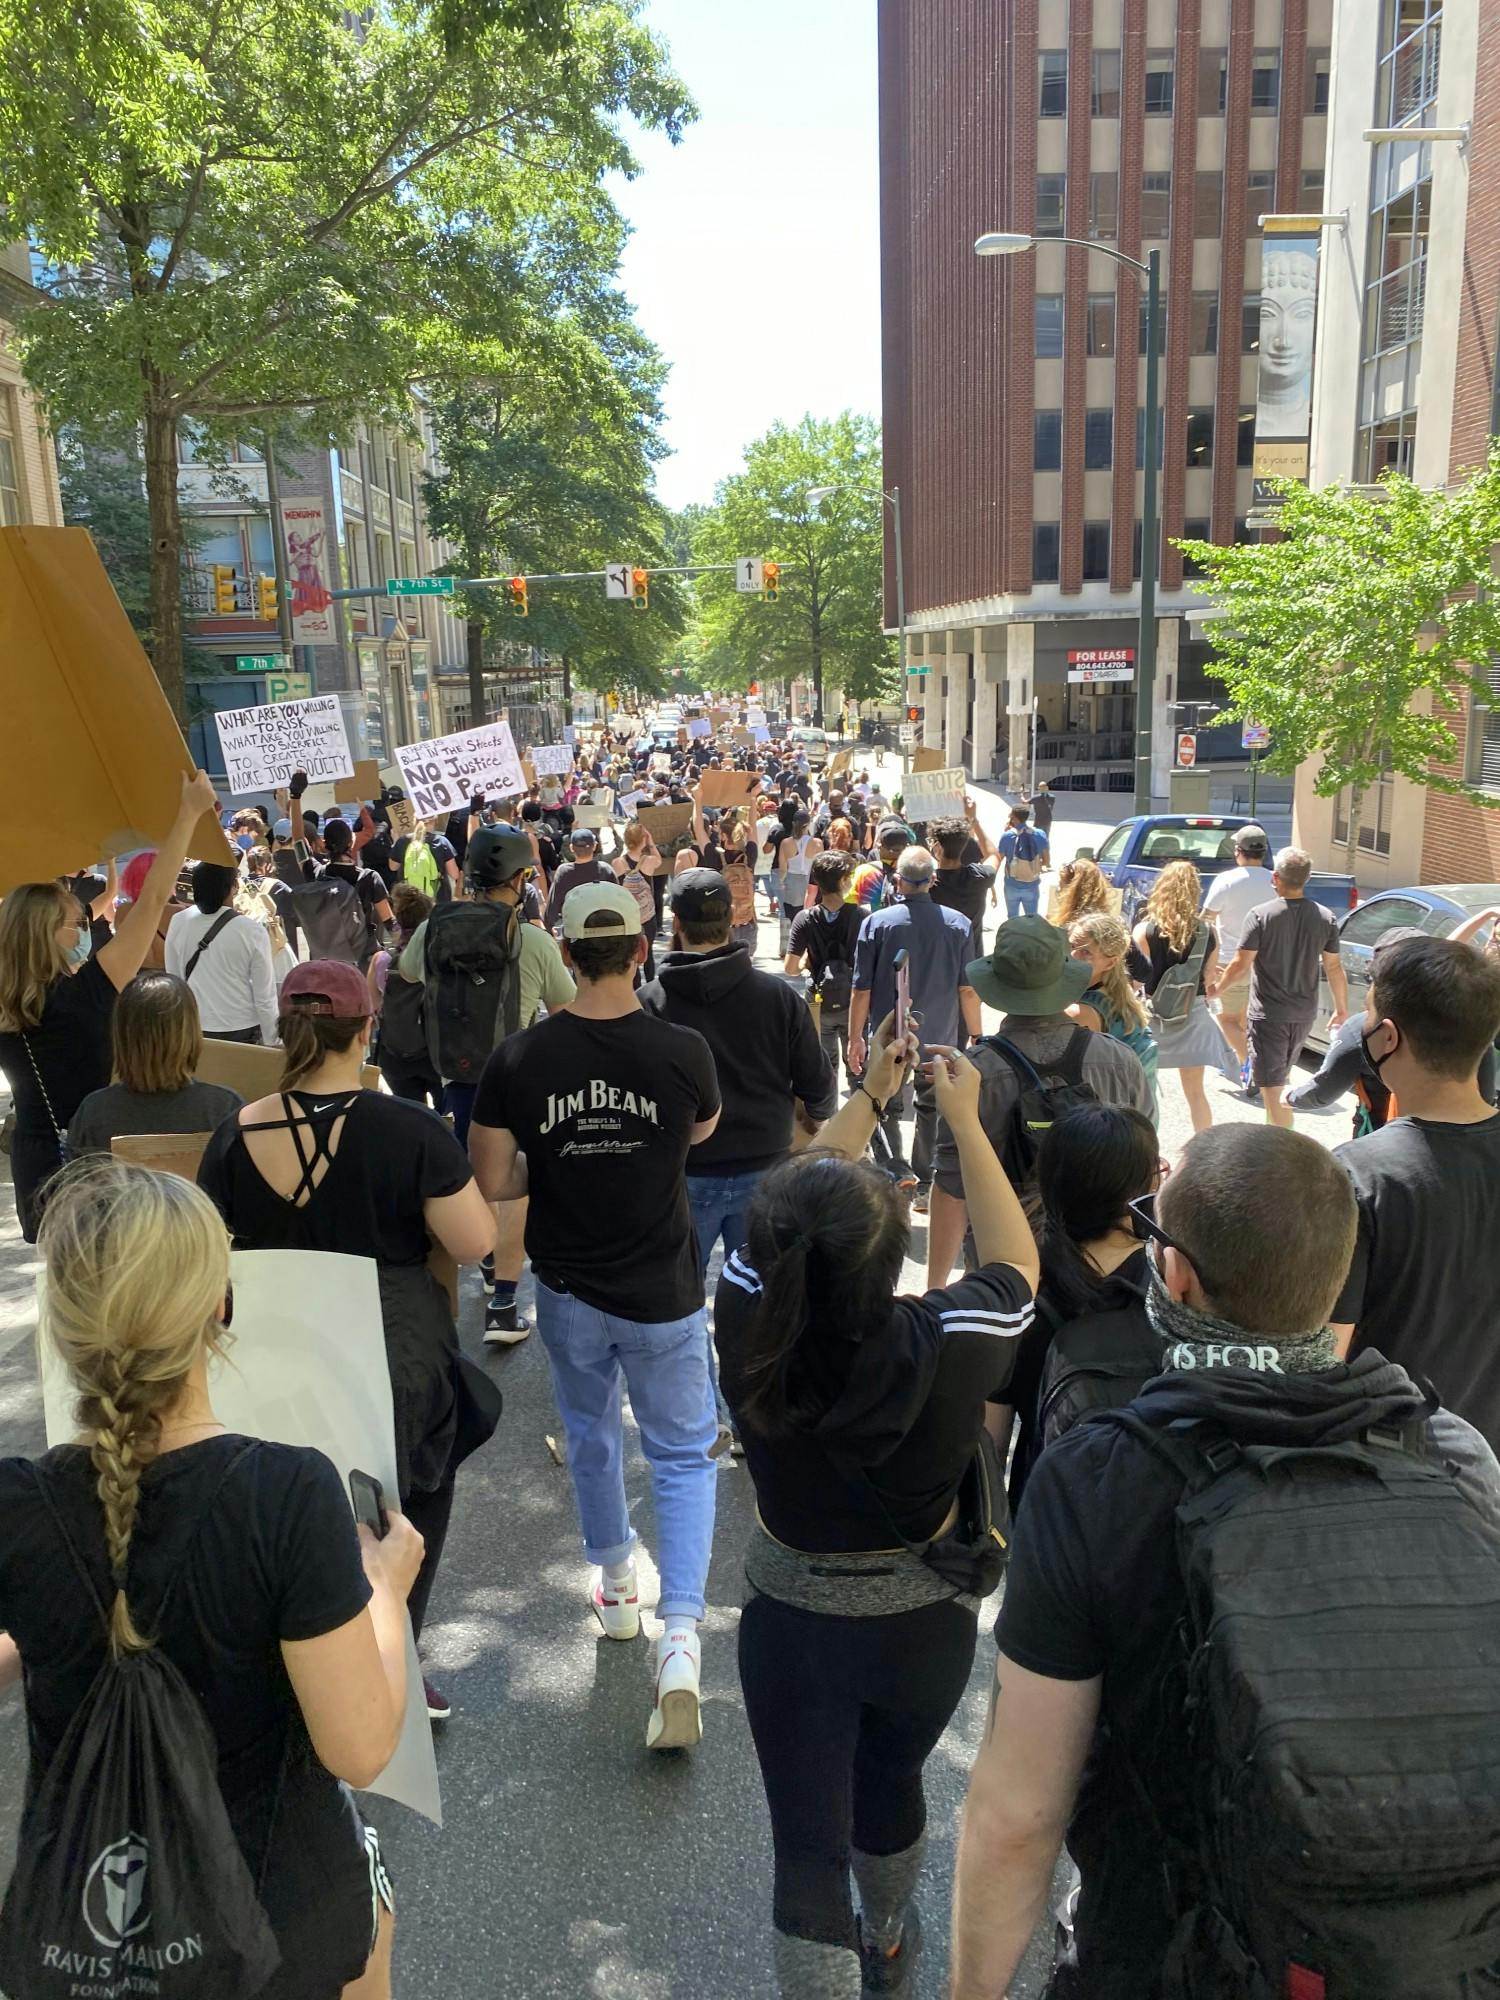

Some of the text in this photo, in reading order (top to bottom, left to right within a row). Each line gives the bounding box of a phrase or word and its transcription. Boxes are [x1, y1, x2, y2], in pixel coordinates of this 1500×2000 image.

[1270, 457, 1288, 467] your
[409, 580, 428, 588] 7th
[251, 658, 268, 669] 7th
[1075, 661, 1127, 670] 804.643.4700
[1076, 650, 1127, 662] FOR LEASE
[270, 679, 289, 702] P
[218, 700, 335, 730] WHAT ARE YOU WILLING
[255, 716, 309, 734] TO RISK
[223, 723, 340, 752] WHAT ARE YOU WILLING
[230, 757, 252, 771] TO
[262, 749, 306, 765] CREATE
[256, 744, 276, 754] TO
[427, 747, 439, 758] IN
[441, 745, 464, 756] THE
[232, 770, 264, 791] MORE
[264, 763, 294, 784] JUST
[403, 762, 442, 788] NO
[444, 756, 502, 778] Justice
[413, 776, 514, 815] NO Peace
[539, 1079, 658, 1134] JIM BEAM
[1173, 1343, 1286, 1375] IS FOR
[41, 1942, 112, 1979] RAVIS
